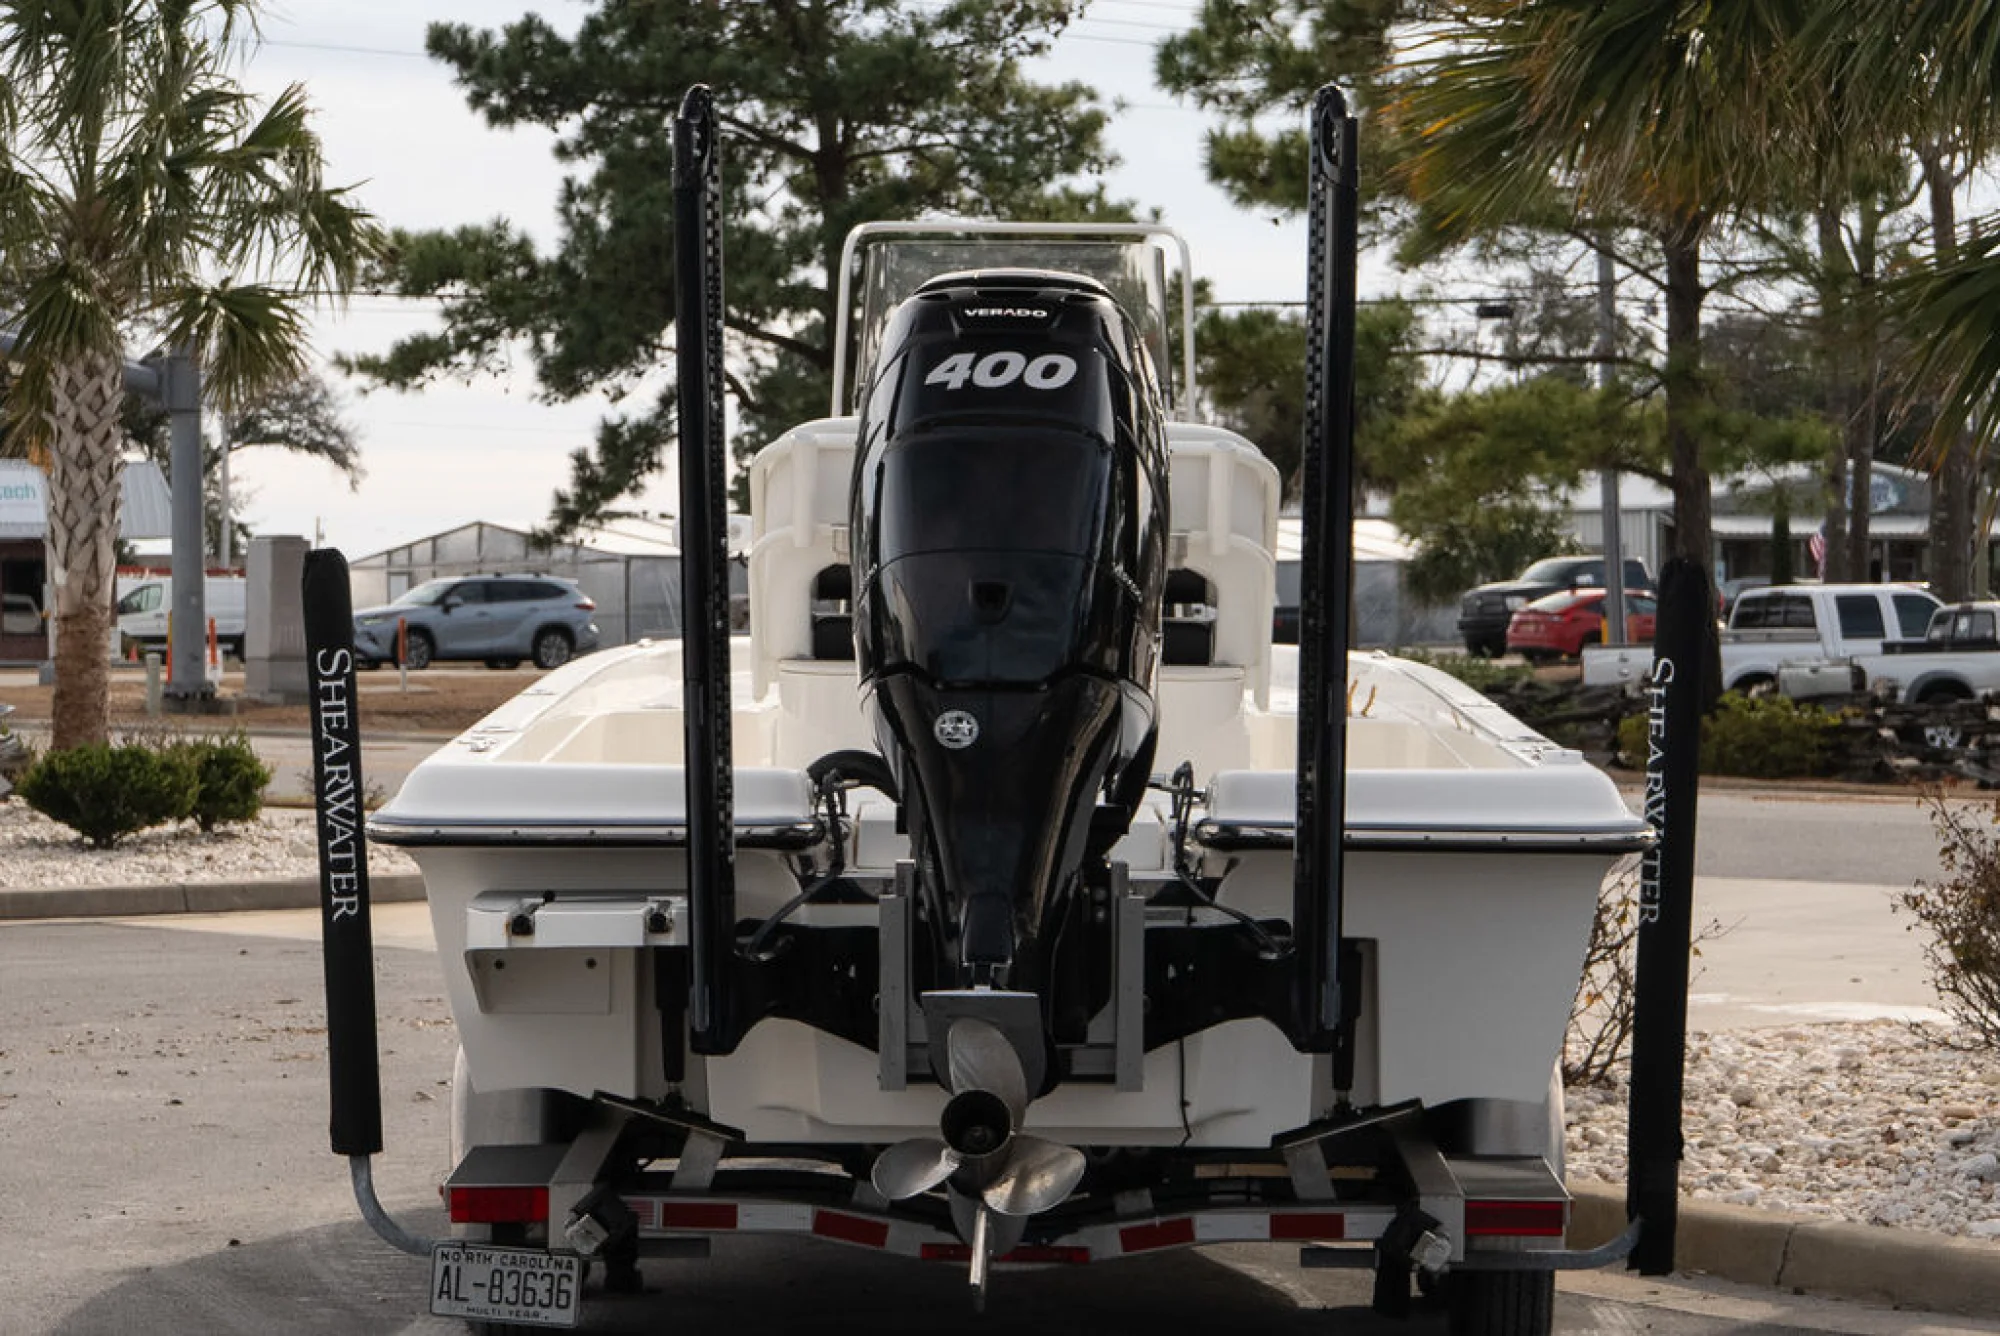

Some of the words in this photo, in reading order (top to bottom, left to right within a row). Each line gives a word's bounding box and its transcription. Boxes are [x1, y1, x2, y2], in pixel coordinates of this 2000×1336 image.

[965, 308, 1047, 318] VERADO
[925, 351, 1078, 389] 400
[0, 482, 36, 500] ech
[317, 648, 359, 922] SHEARWATER
[1640, 657, 1675, 923] SHEARWTER
[440, 1251, 493, 1264] NORTH
[437, 1265, 573, 1309] AL-83636
